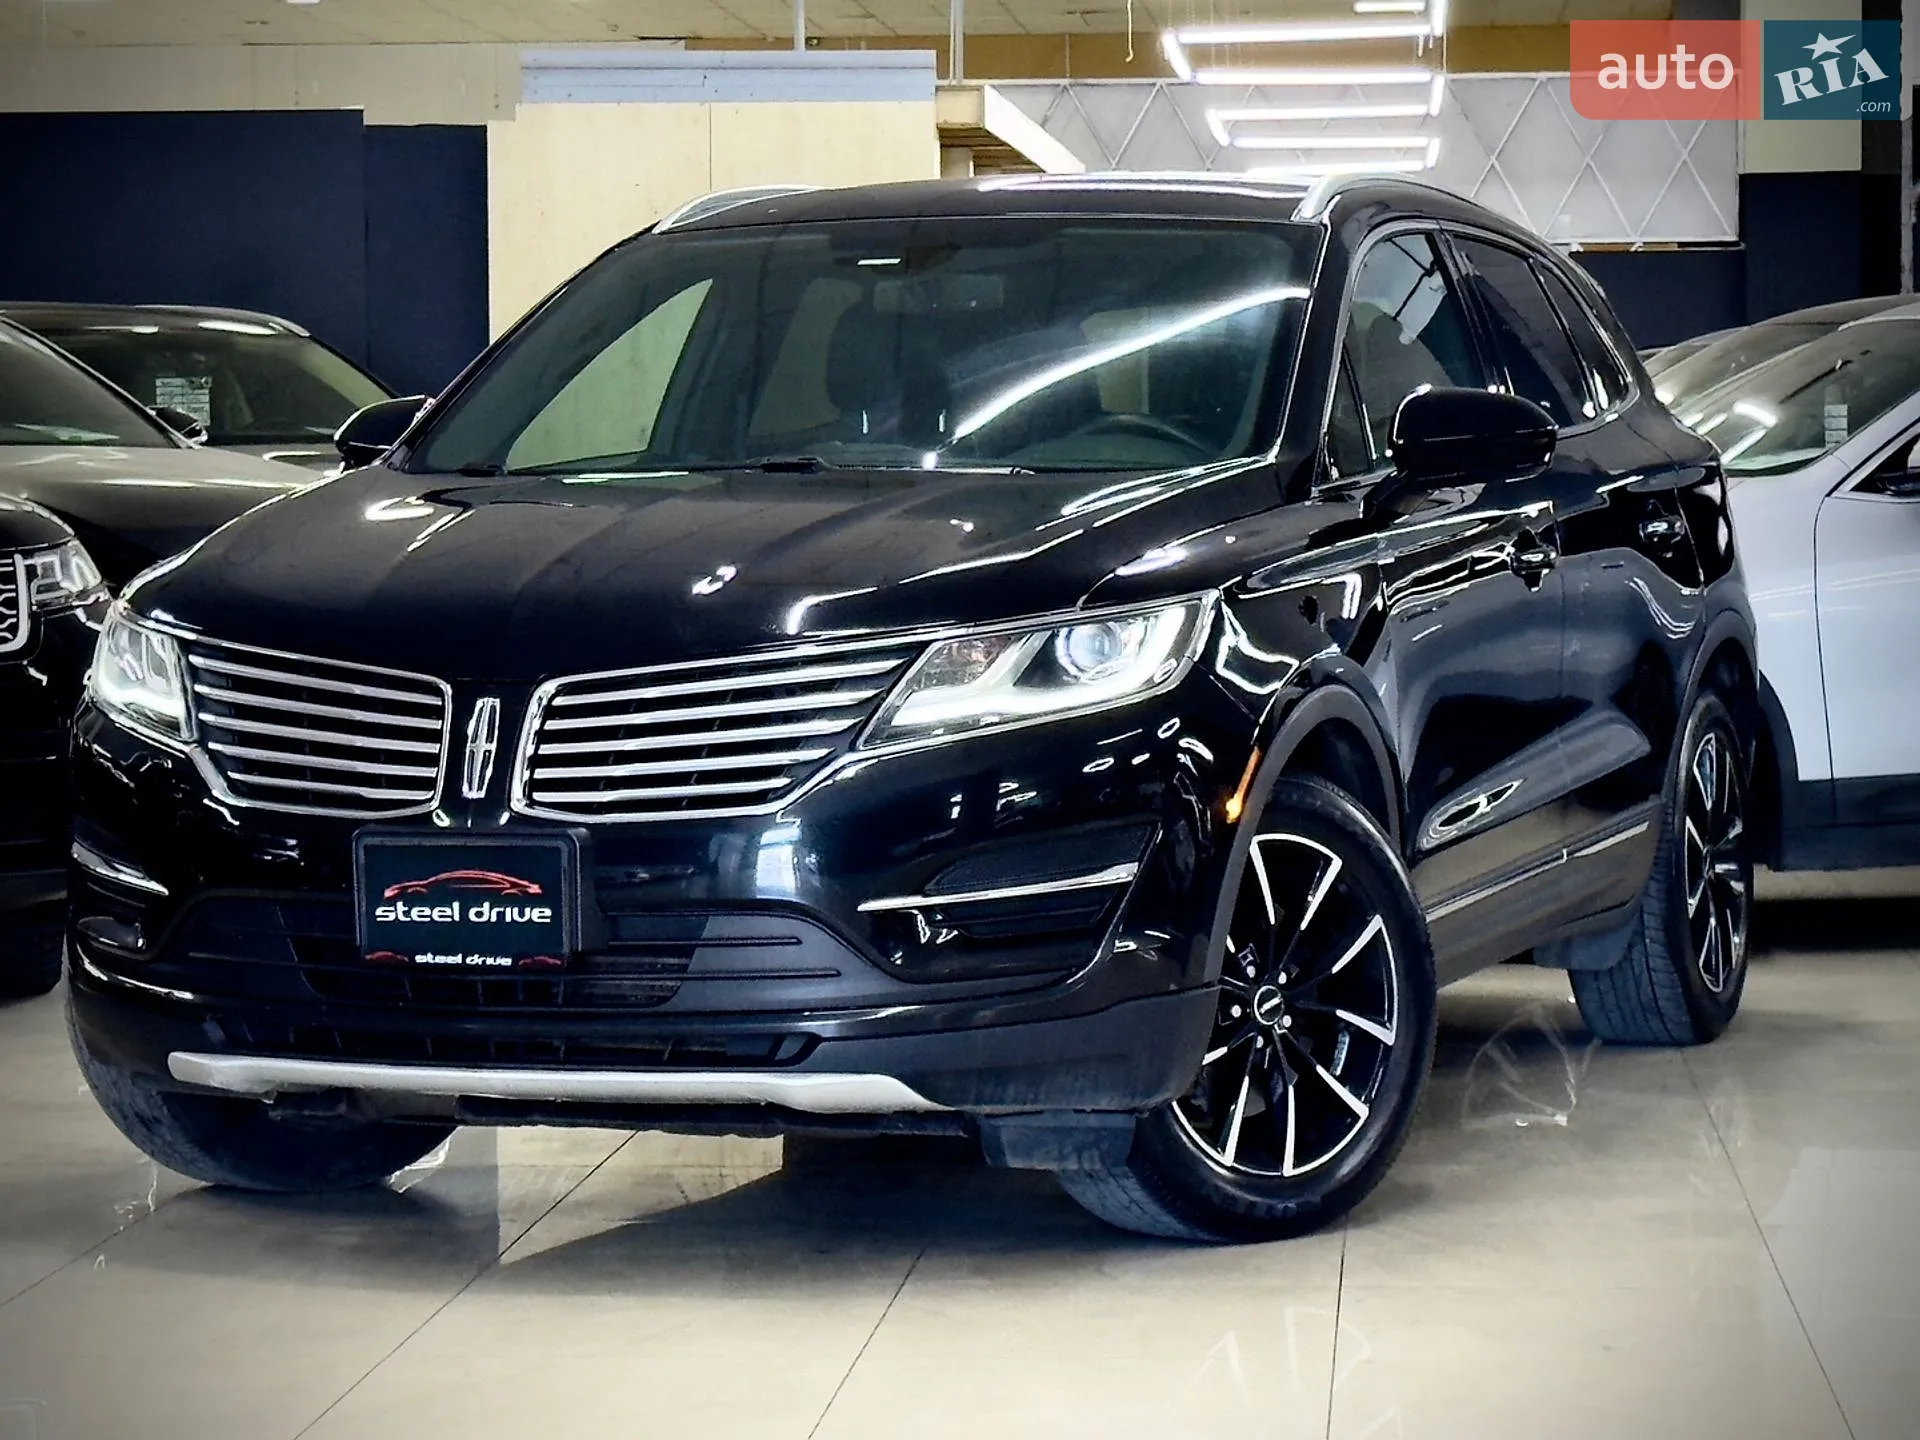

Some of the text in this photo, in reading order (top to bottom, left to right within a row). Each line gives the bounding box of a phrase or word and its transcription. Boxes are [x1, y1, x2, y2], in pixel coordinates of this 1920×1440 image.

[375, 901, 552, 923] steel drive
[414, 952, 513, 967] steel drive
